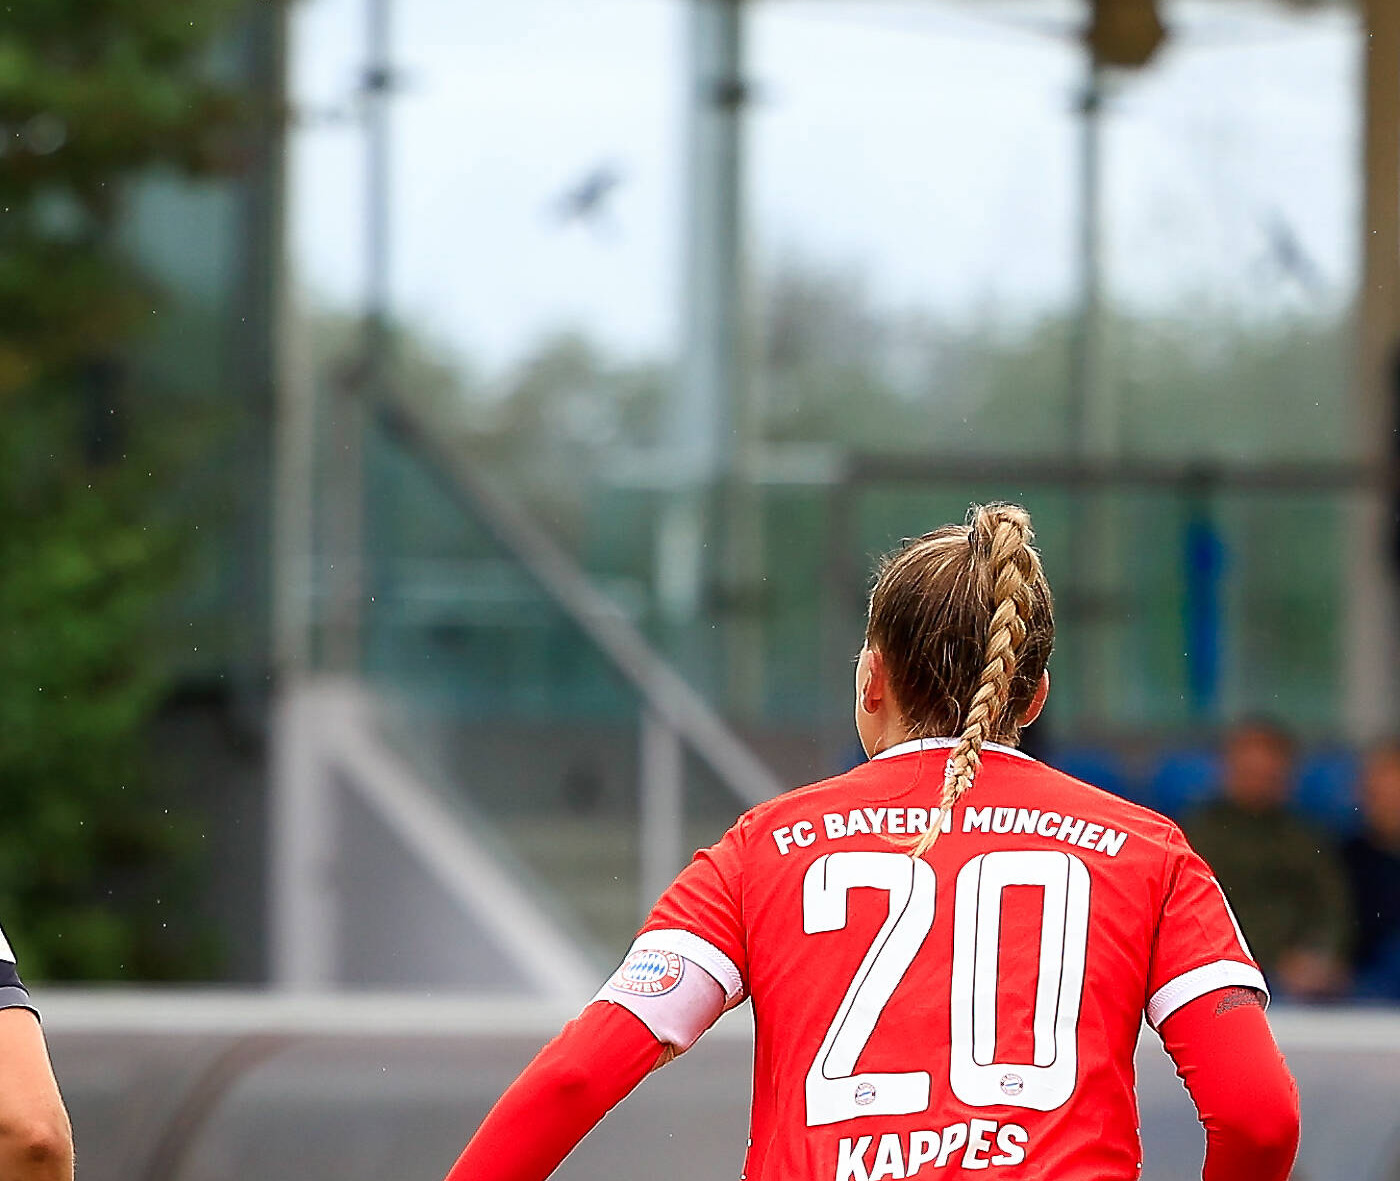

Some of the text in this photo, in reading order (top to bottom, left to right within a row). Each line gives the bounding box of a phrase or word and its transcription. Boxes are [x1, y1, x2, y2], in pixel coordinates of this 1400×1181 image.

[772, 806, 1129, 858] FC BAYERN MÜNCHEN
[802, 850, 1091, 1127] 20
